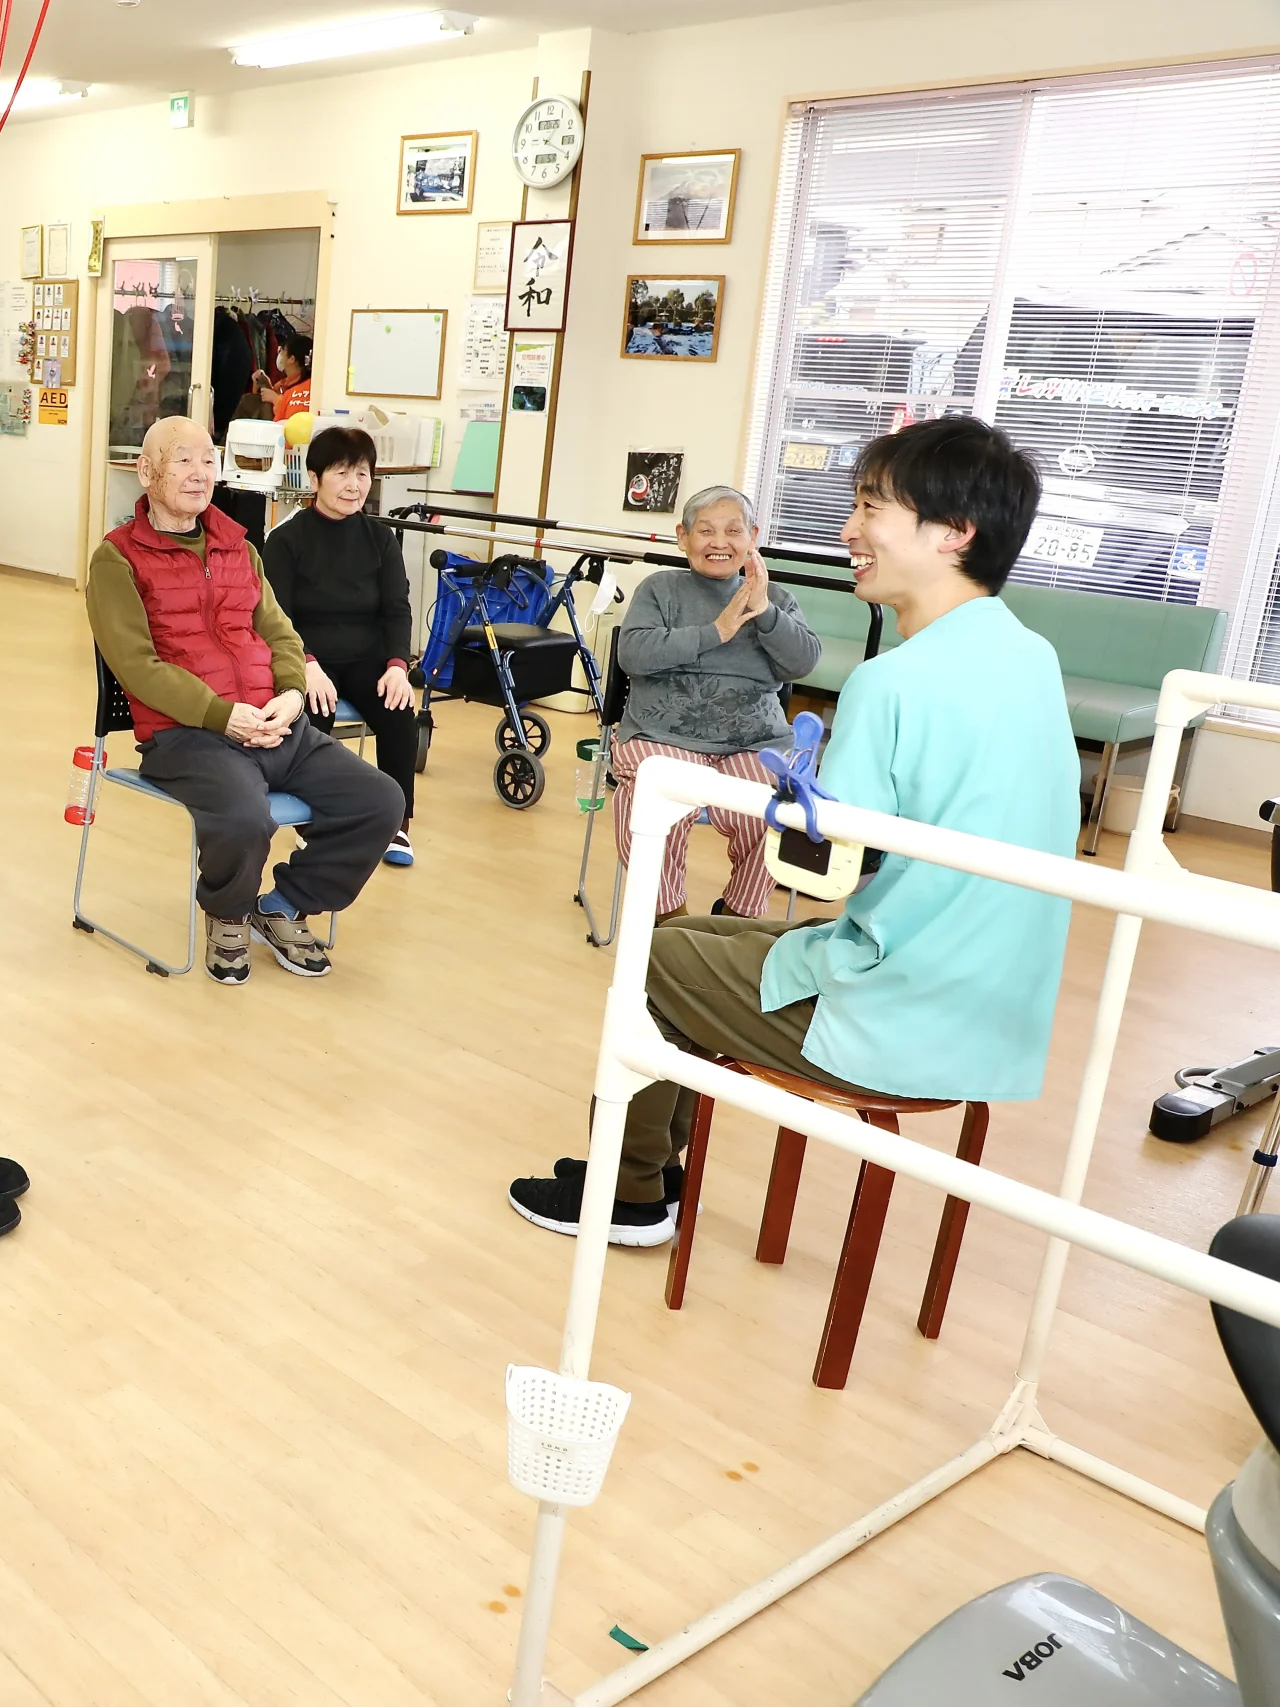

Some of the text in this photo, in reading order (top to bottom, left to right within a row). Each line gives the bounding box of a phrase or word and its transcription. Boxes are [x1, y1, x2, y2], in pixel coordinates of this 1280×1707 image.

[547, 105, 555, 115] 12
[517, 236, 559, 318] 令和
[40, 392, 67, 405] AED
[1033, 537, 1094, 563] 20-85
[1002, 1633, 1063, 1681] JOBA
